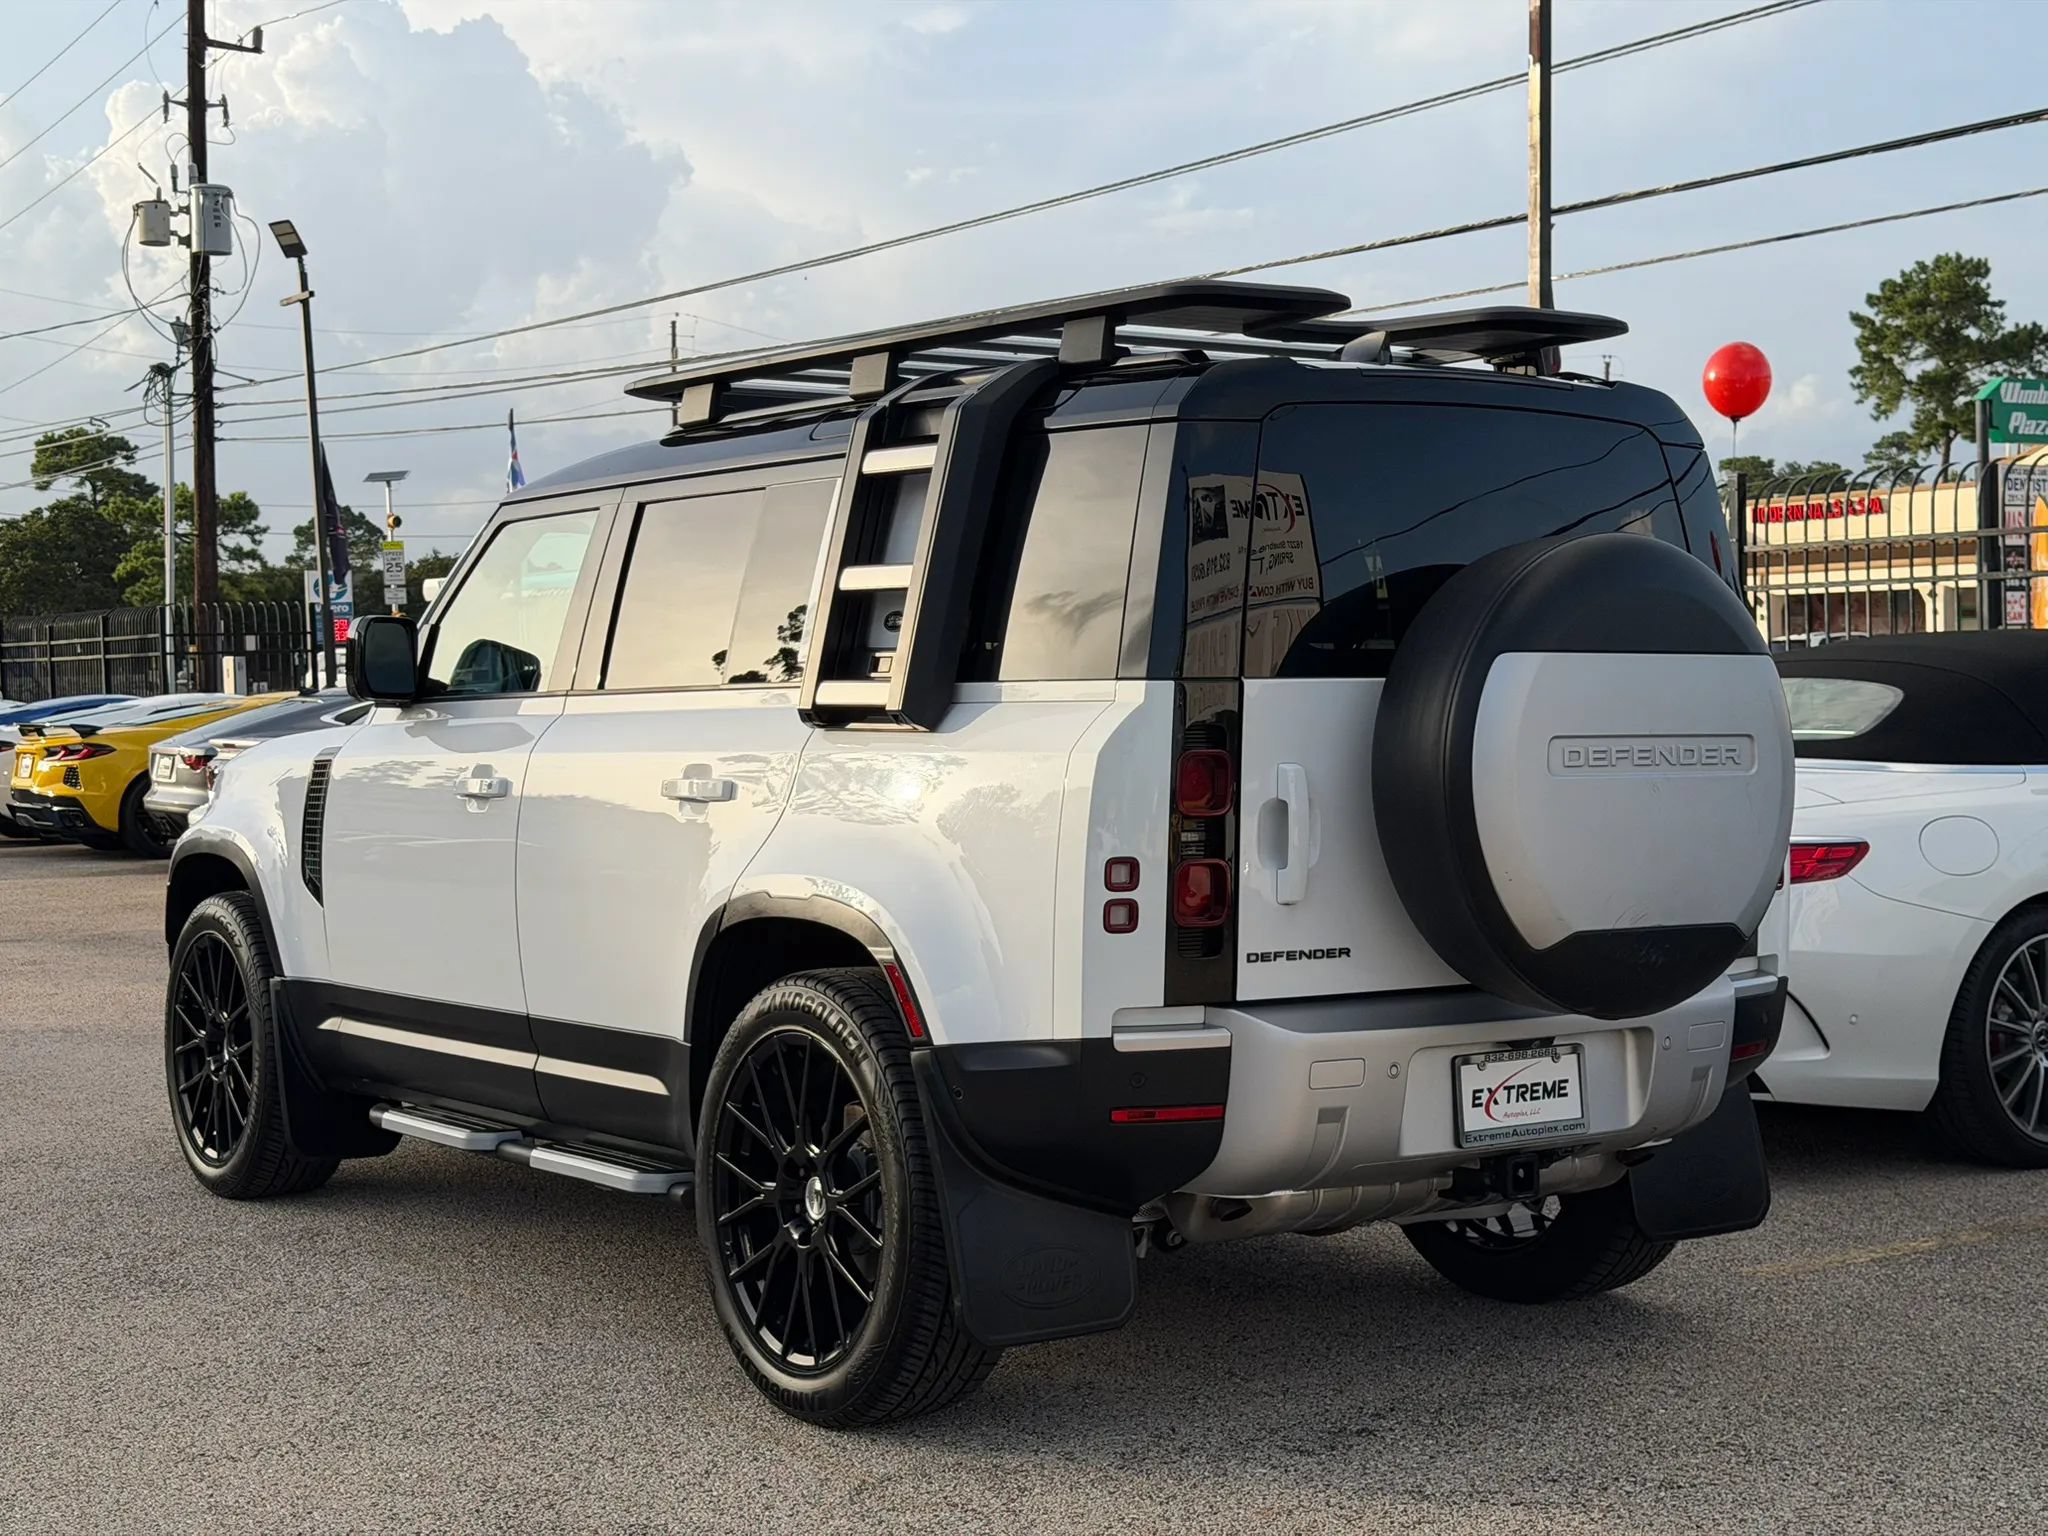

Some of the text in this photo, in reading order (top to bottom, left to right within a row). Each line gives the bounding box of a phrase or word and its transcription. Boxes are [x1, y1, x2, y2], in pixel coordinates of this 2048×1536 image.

[2007, 478, 2048, 493] DENIST
[386, 562, 404, 573] 25
[1561, 743, 1742, 768] DEFENDER
[1246, 947, 1352, 963] DEFENDER
[1471, 1078, 1570, 1108] EXTREME
[1464, 1121, 1586, 1144] ExtremeAutoplex.com
